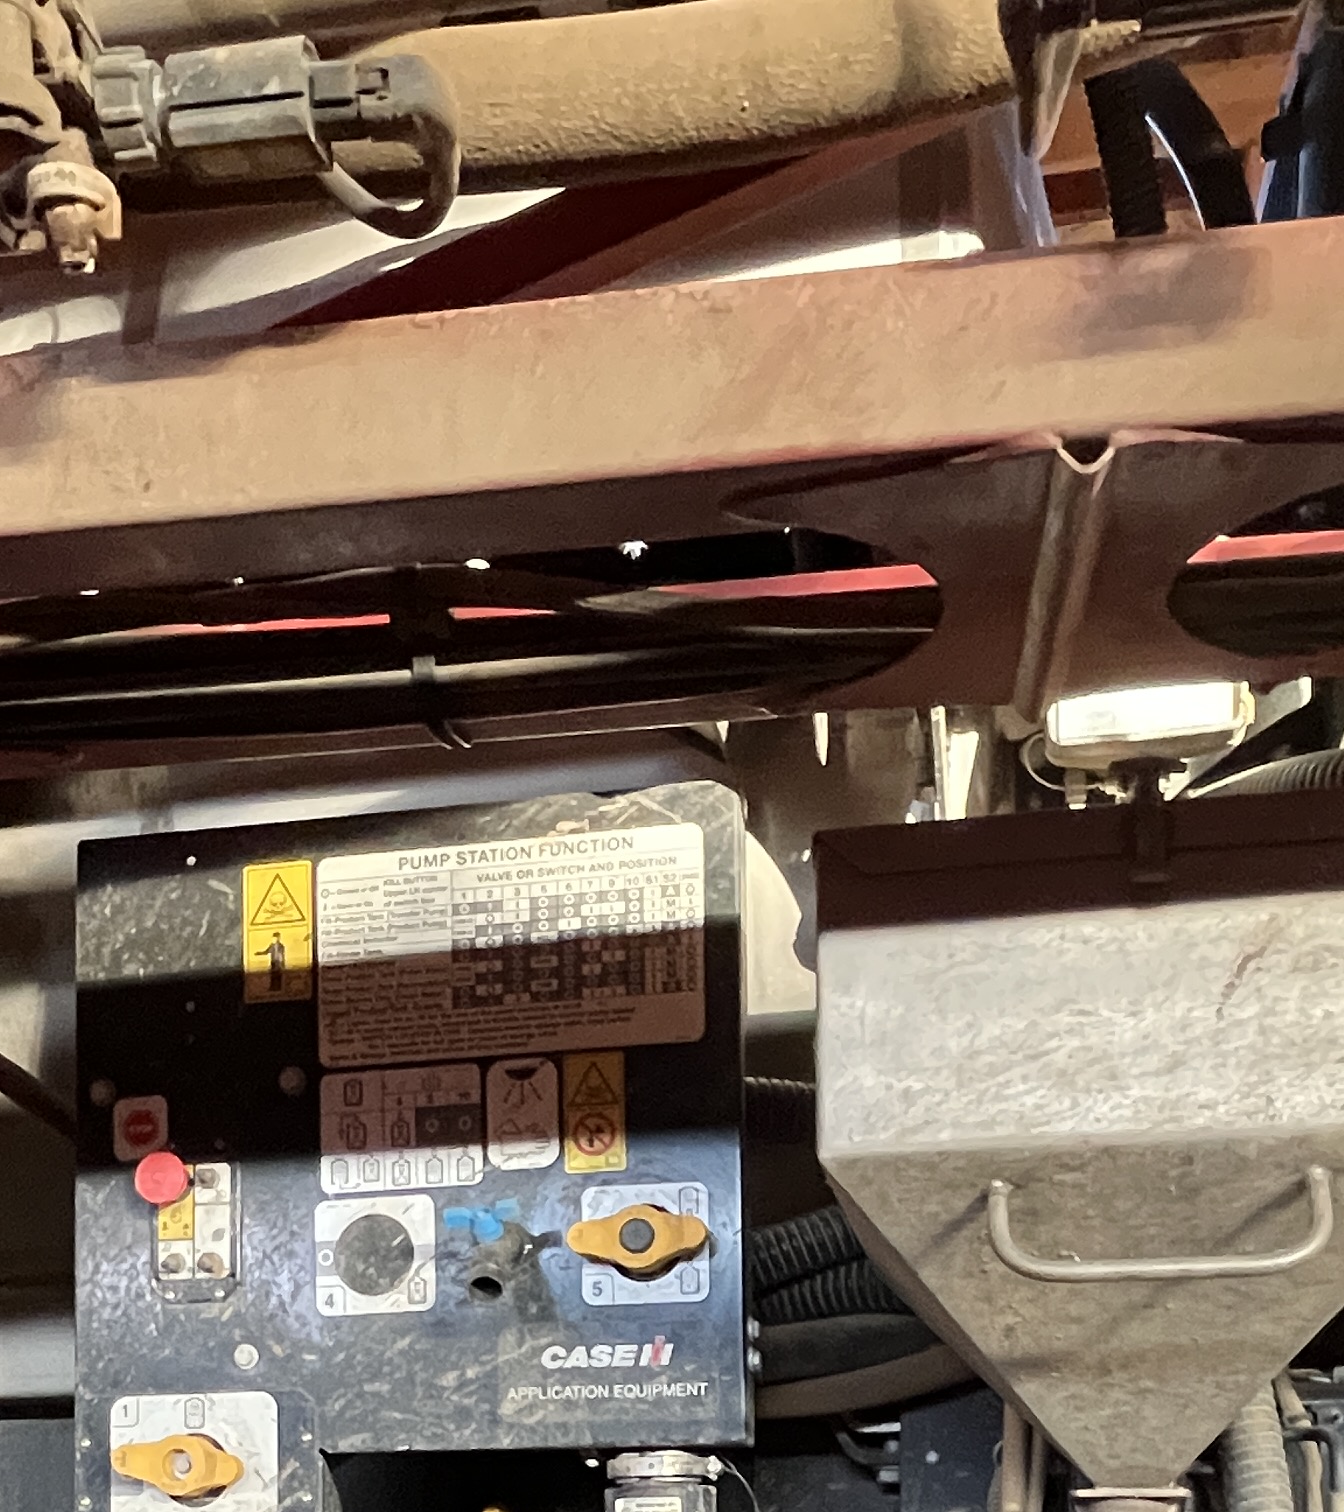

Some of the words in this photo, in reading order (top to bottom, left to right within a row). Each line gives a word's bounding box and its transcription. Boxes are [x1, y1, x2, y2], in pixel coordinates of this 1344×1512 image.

[398, 853, 450, 871] PUMP
[456, 845, 532, 866] STATION
[539, 836, 633, 857] FUNCTION
[476, 870, 513, 882] VALVE
[516, 869, 534, 880] OR
[537, 864, 585, 877] SWITCH
[588, 861, 614, 872] AND
[619, 856, 677, 870] POSITION
[626, 876, 640, 886] 10
[592, 1280, 603, 1298] 5
[324, 1292, 335, 1309] 4
[540, 1343, 638, 1369] CASE
[506, 1384, 609, 1401] APPLICATION
[613, 1382, 709, 1399] EQUIPMENT
[122, 1404, 128, 1418] 1
